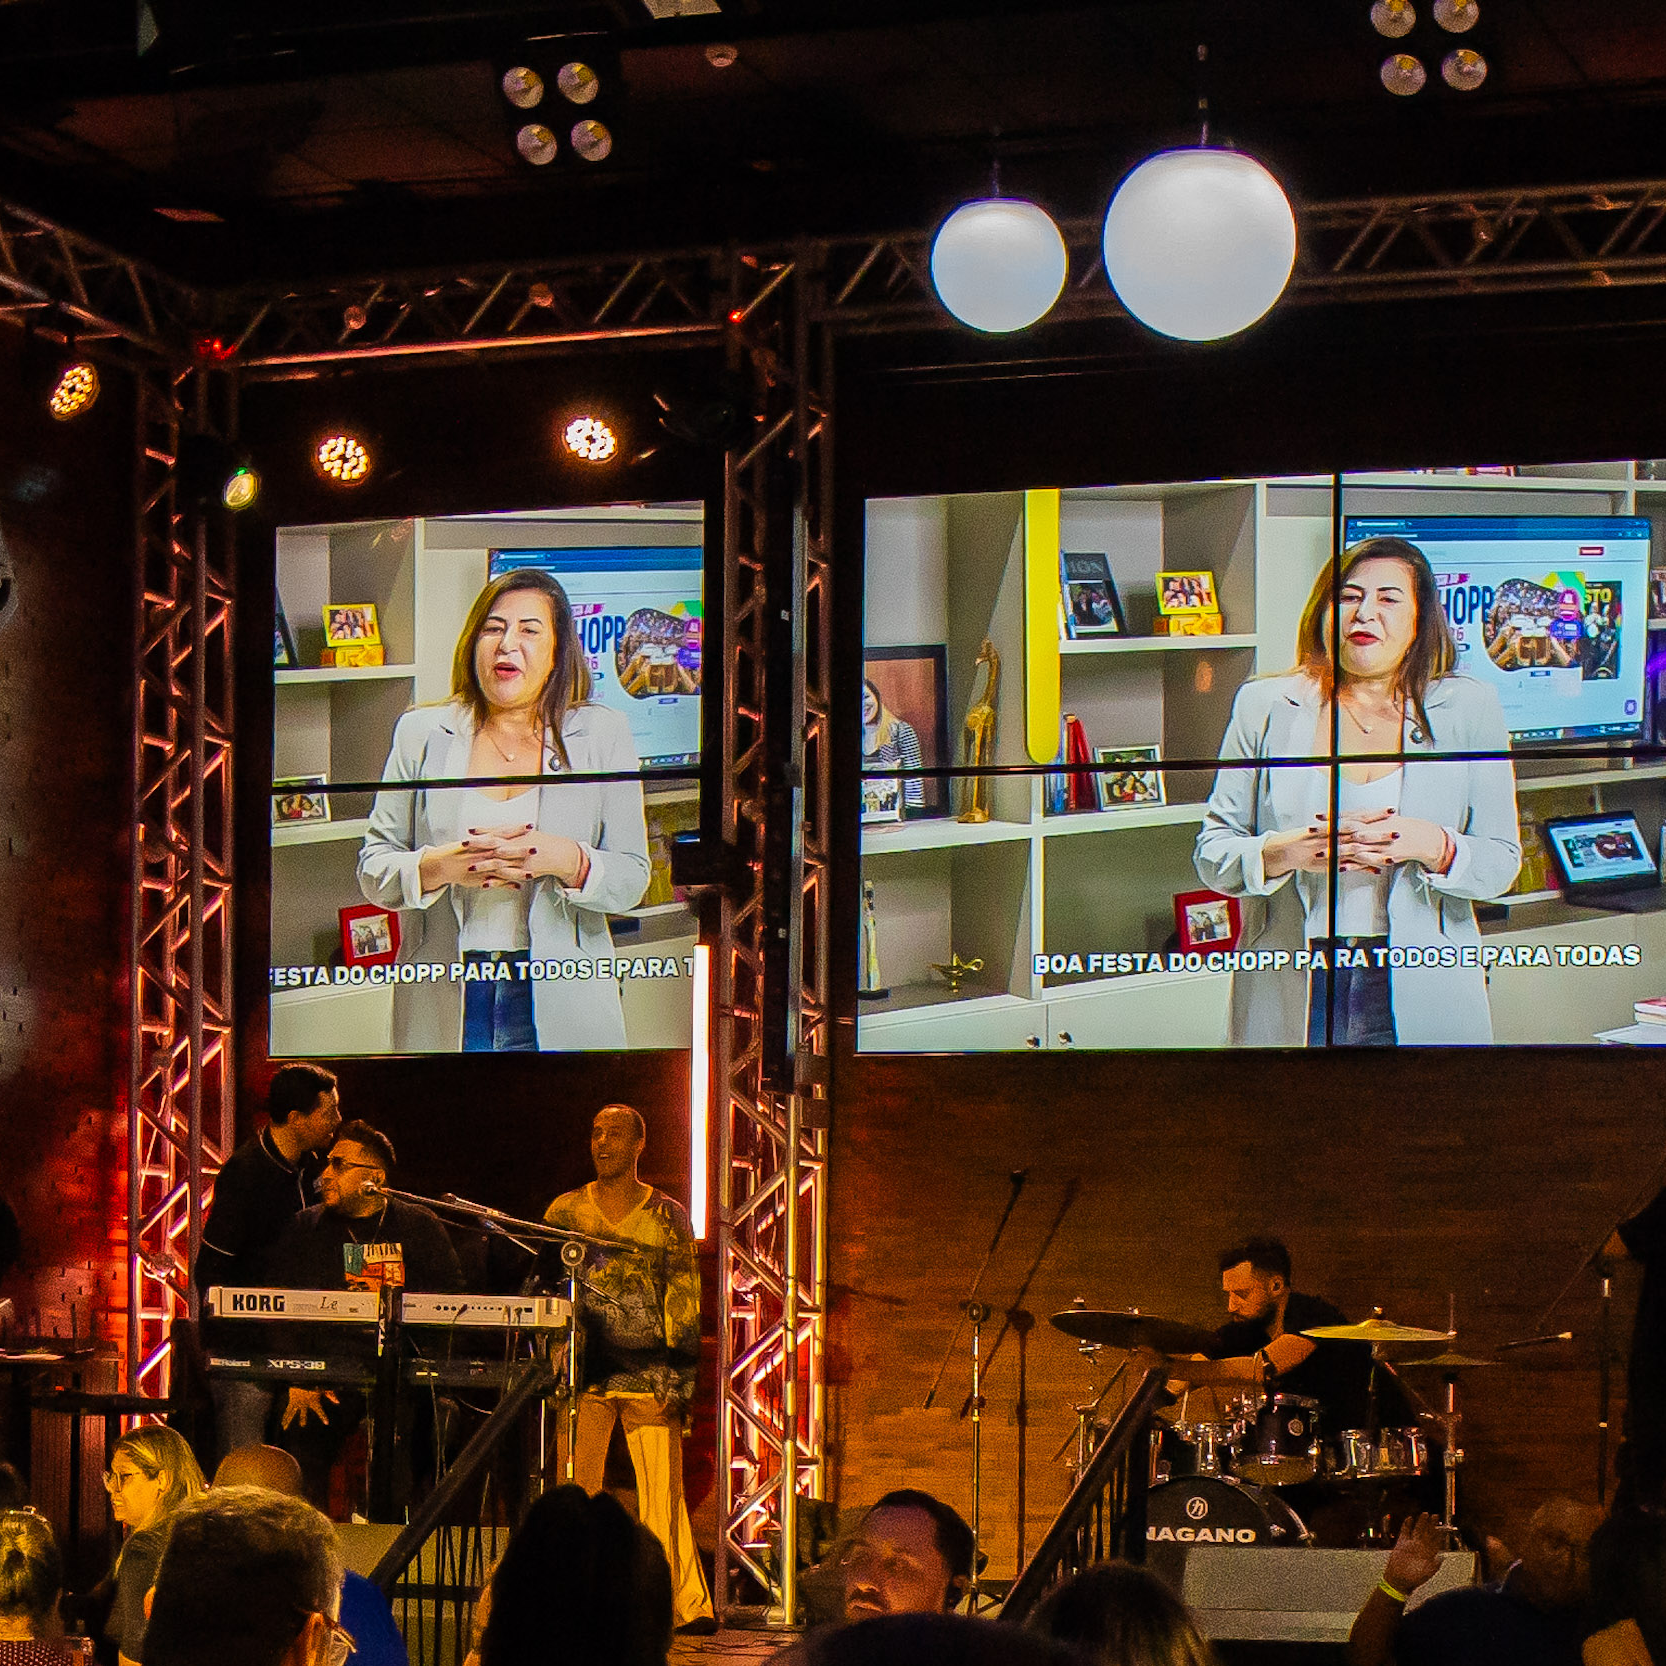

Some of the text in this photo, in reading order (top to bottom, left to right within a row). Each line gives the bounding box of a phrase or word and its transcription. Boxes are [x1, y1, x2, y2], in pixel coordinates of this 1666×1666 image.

[334, 965, 365, 985] DO
[369, 963, 446, 984] CHOPP
[450, 961, 512, 982] PARA
[514, 959, 593, 980] TODOS
[596, 958, 612, 979] E
[615, 957, 680, 978] PARA
[1033, 953, 1083, 974] BOA
[1087, 952, 1164, 973] FESTA
[1168, 952, 1204, 972] DO
[1206, 951, 1291, 972] CHOPP
[1373, 946, 1457, 968] TODOS
[1461, 946, 1479, 967] E
[1483, 946, 1551, 967] PARA
[1554, 945, 1641, 966] TODAS
[232, 1294, 285, 1312] KORG
